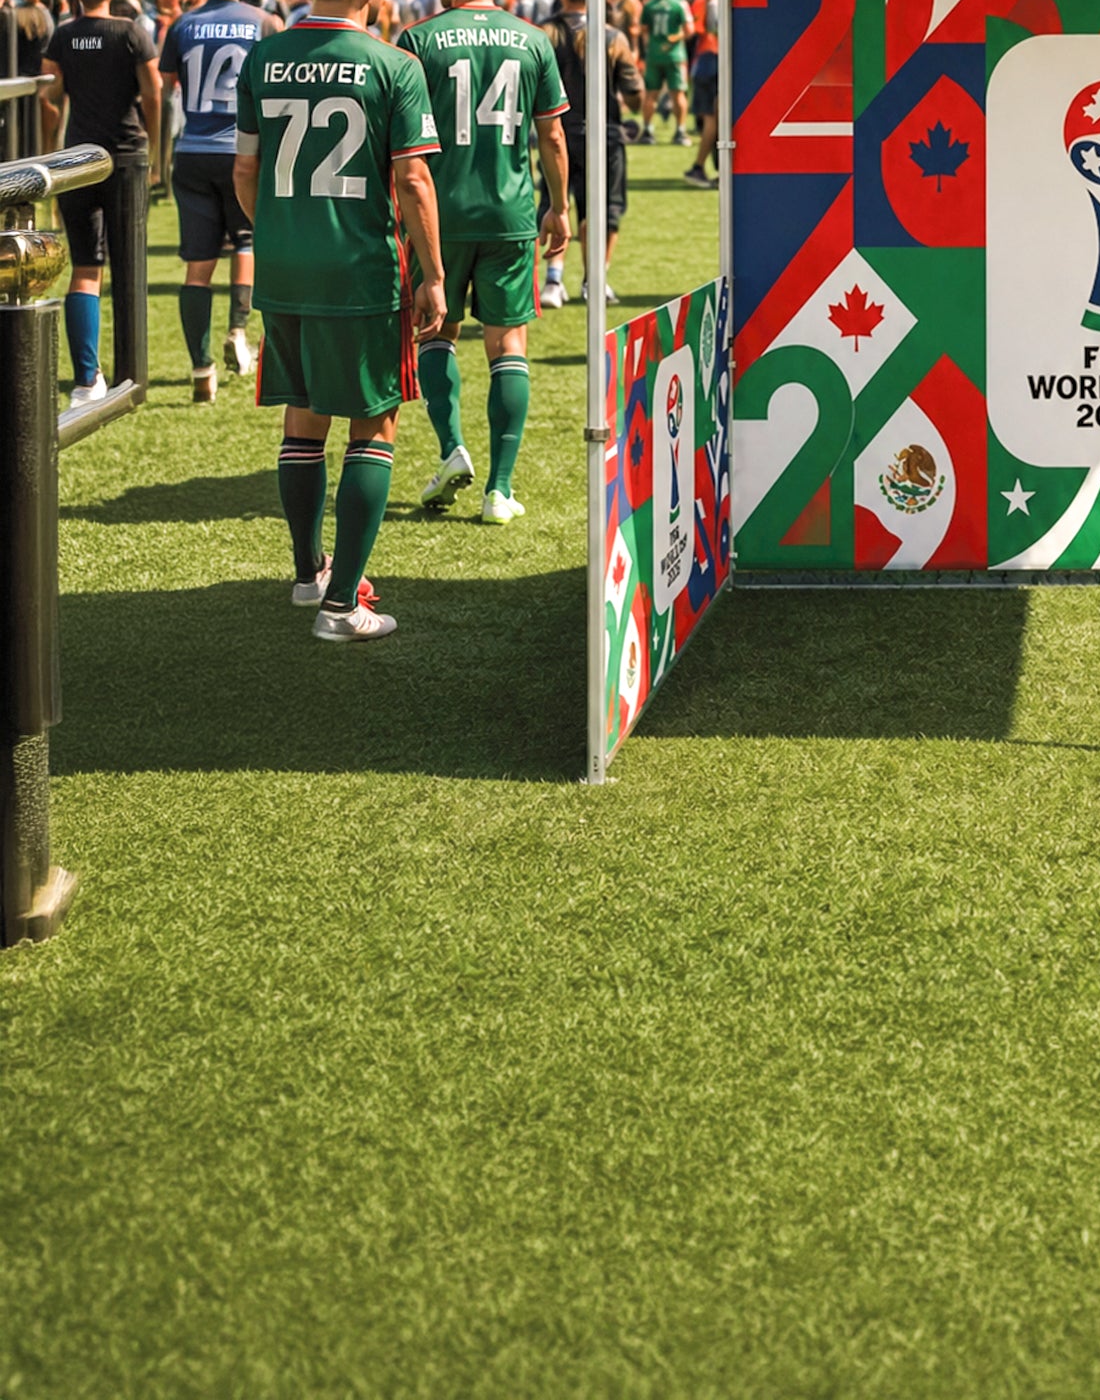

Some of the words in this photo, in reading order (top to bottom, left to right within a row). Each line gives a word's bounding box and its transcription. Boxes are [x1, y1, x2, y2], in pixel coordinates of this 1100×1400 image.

[434, 27, 530, 51] HERNANDEZ
[448, 58, 524, 146] 14
[261, 97, 367, 200] 72
